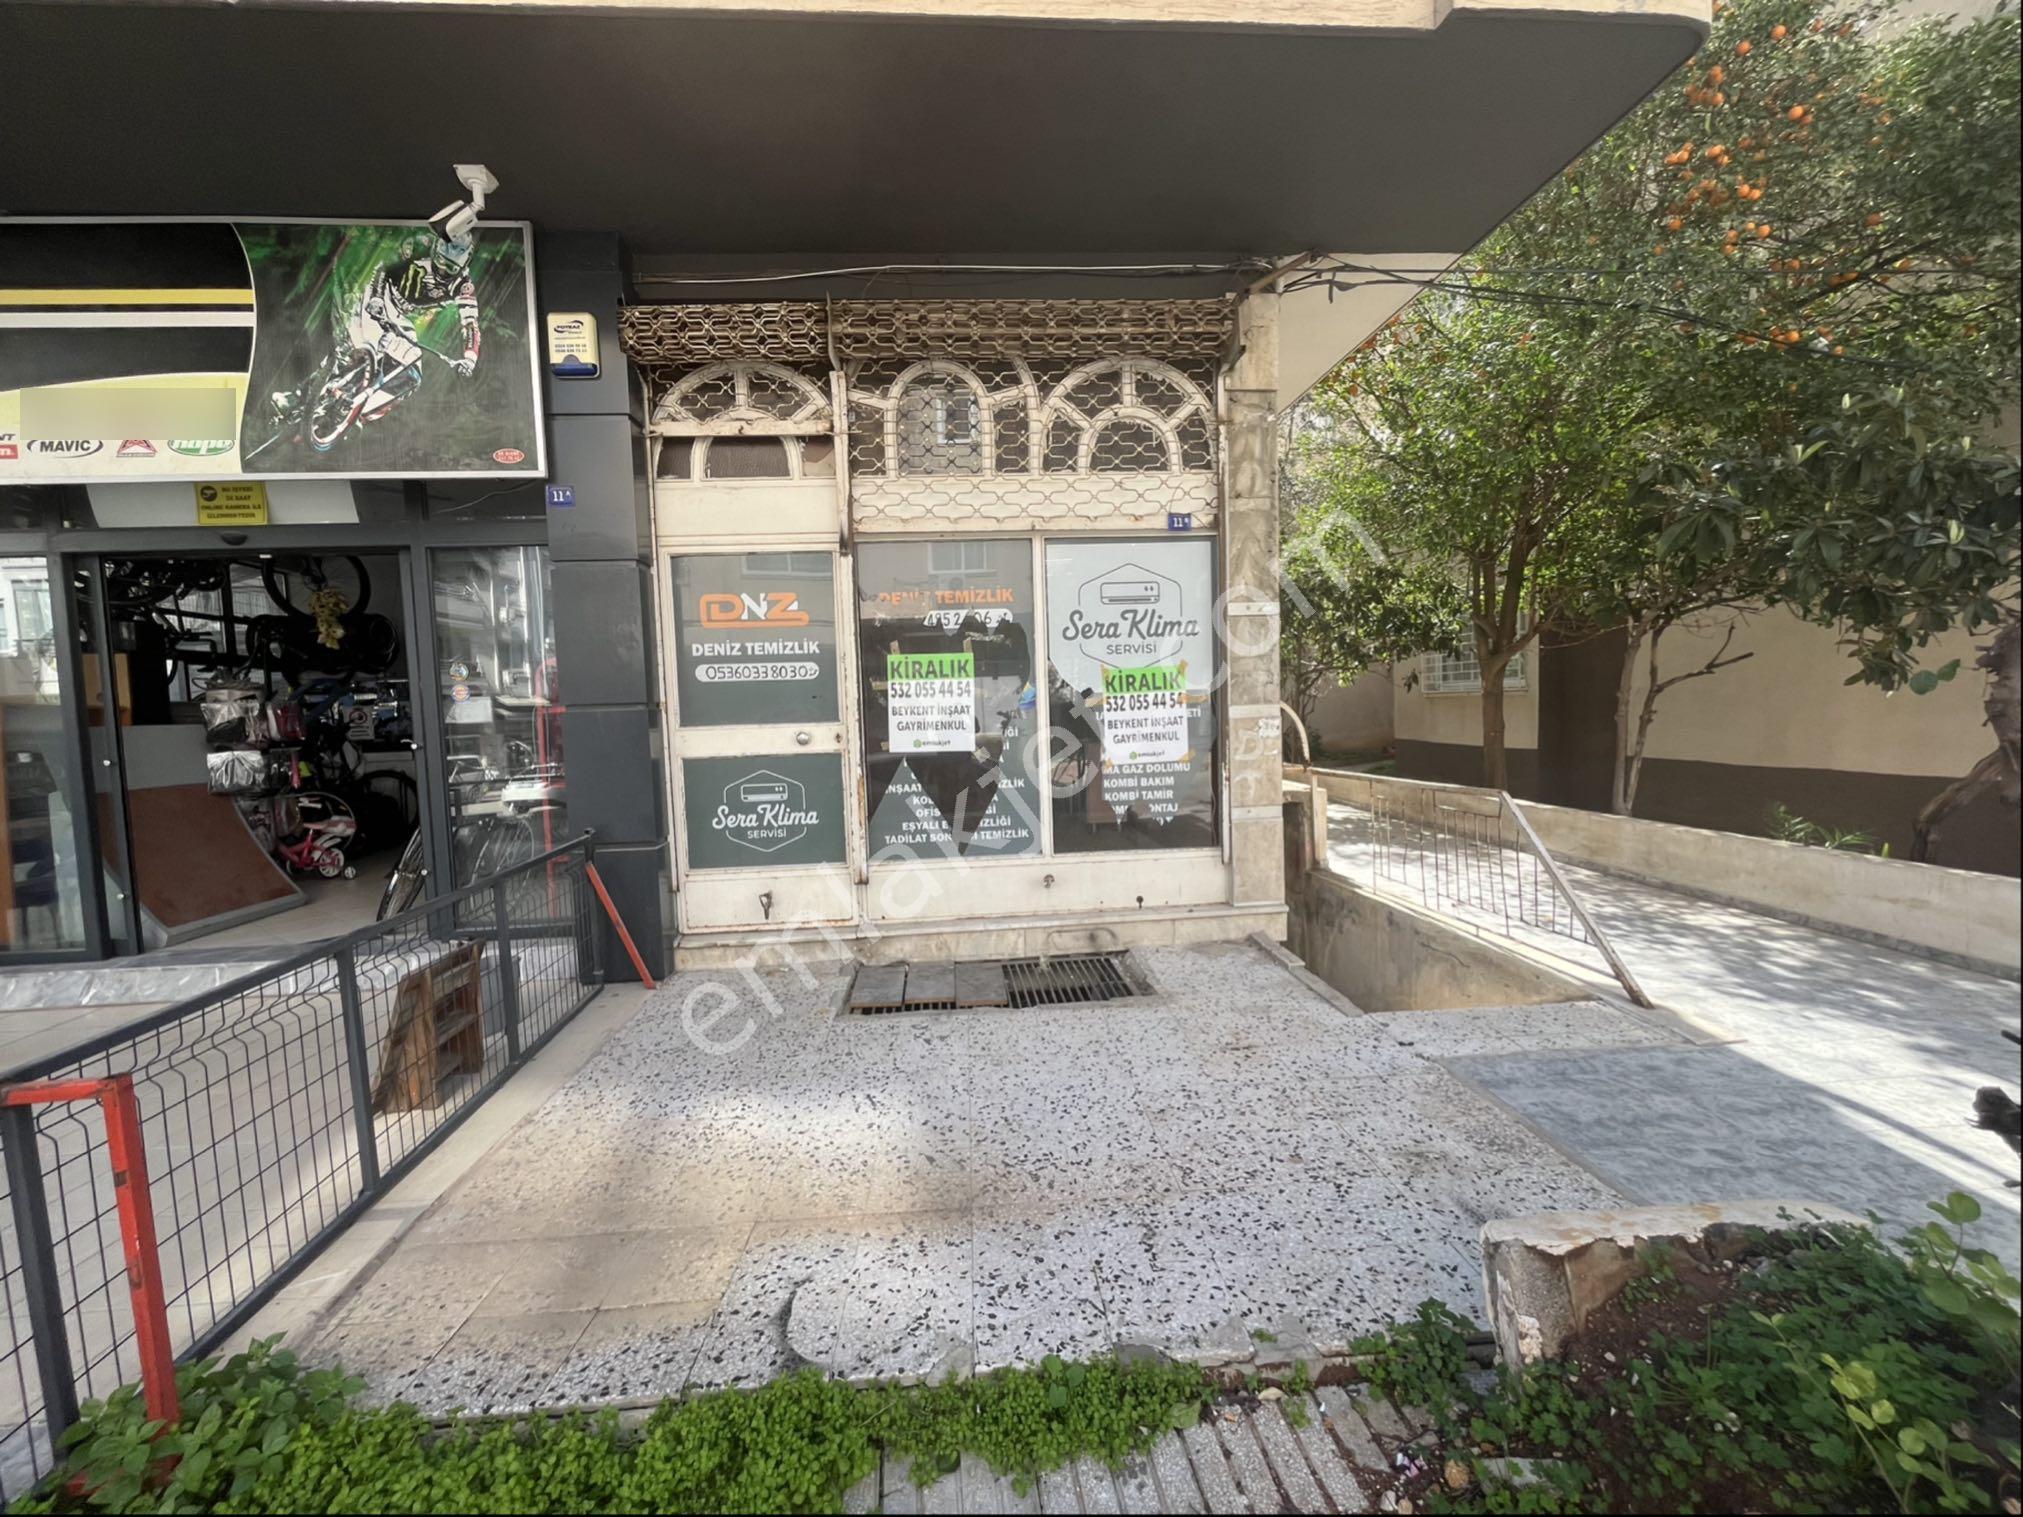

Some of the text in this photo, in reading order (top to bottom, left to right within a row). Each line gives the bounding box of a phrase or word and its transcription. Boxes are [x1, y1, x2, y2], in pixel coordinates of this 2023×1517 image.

[40, 440, 91, 452] MAVIC
[935, 585, 1015, 604] TEMİZLİK
[699, 592, 810, 629] DNZ
[1062, 608, 1200, 641] Sera Klima
[691, 638, 821, 656] DENİZ TEMİZLİK
[1106, 643, 1157, 655] SERVİSİ
[705, 665, 809, 680] 05360338030
[890, 656, 970, 679] KİRALIK
[1104, 670, 1180, 693] KİRALIK
[890, 680, 971, 698] 532 055 44 54
[1106, 695, 1126, 712] 532
[1129, 694, 1149, 711] 055
[1152, 693, 1166, 709] 44
[892, 704, 971, 717] BEYKENT İNŞAAT
[897, 719, 966, 731] GAYRİMENKUL
[1107, 716, 1184, 730] BEYKENT İNŞAAT
[1112, 731, 1180, 744] GAYRİMENKUL
[1122, 764, 1144, 774] GAZ
[1146, 762, 1191, 773] DOLUMU
[1104, 776, 1175, 788] KOMBİ BAKIM
[1104, 789, 1174, 801] KOMBİ TAMİR
[712, 803, 820, 829] Sera Klima
[747, 826, 787, 839] SERVİSİ
[902, 821, 939, 832] EŞYALI
[884, 833, 927, 844] TADİLAT
[979, 828, 1030, 840] TEMİZLİK
